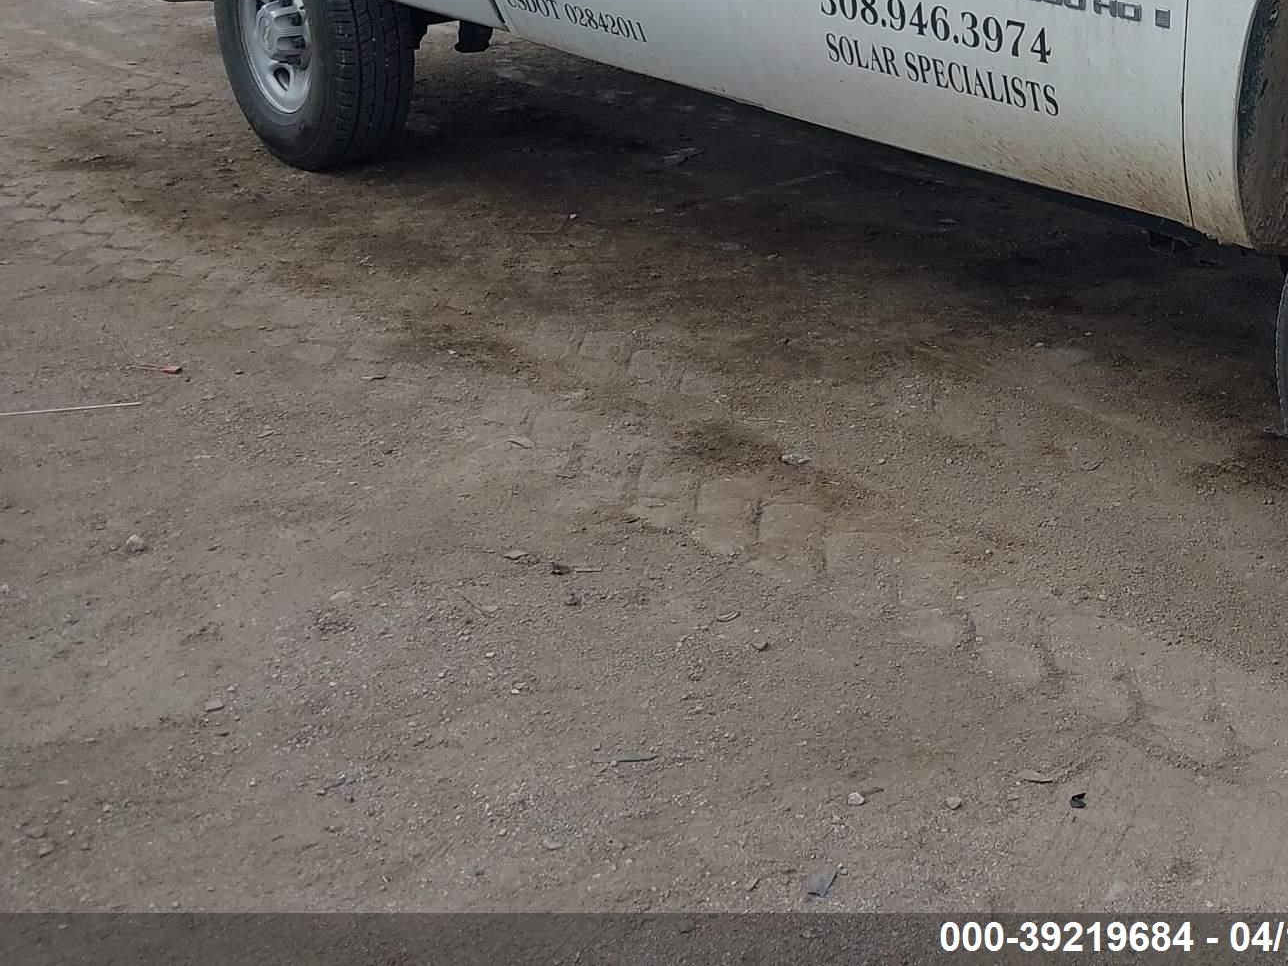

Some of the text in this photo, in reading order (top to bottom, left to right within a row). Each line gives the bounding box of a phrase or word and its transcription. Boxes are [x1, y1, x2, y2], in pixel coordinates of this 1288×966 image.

[564, 3, 648, 43] 02842011
[826, 32, 1059, 116] SOLAR SPECIALISTS
